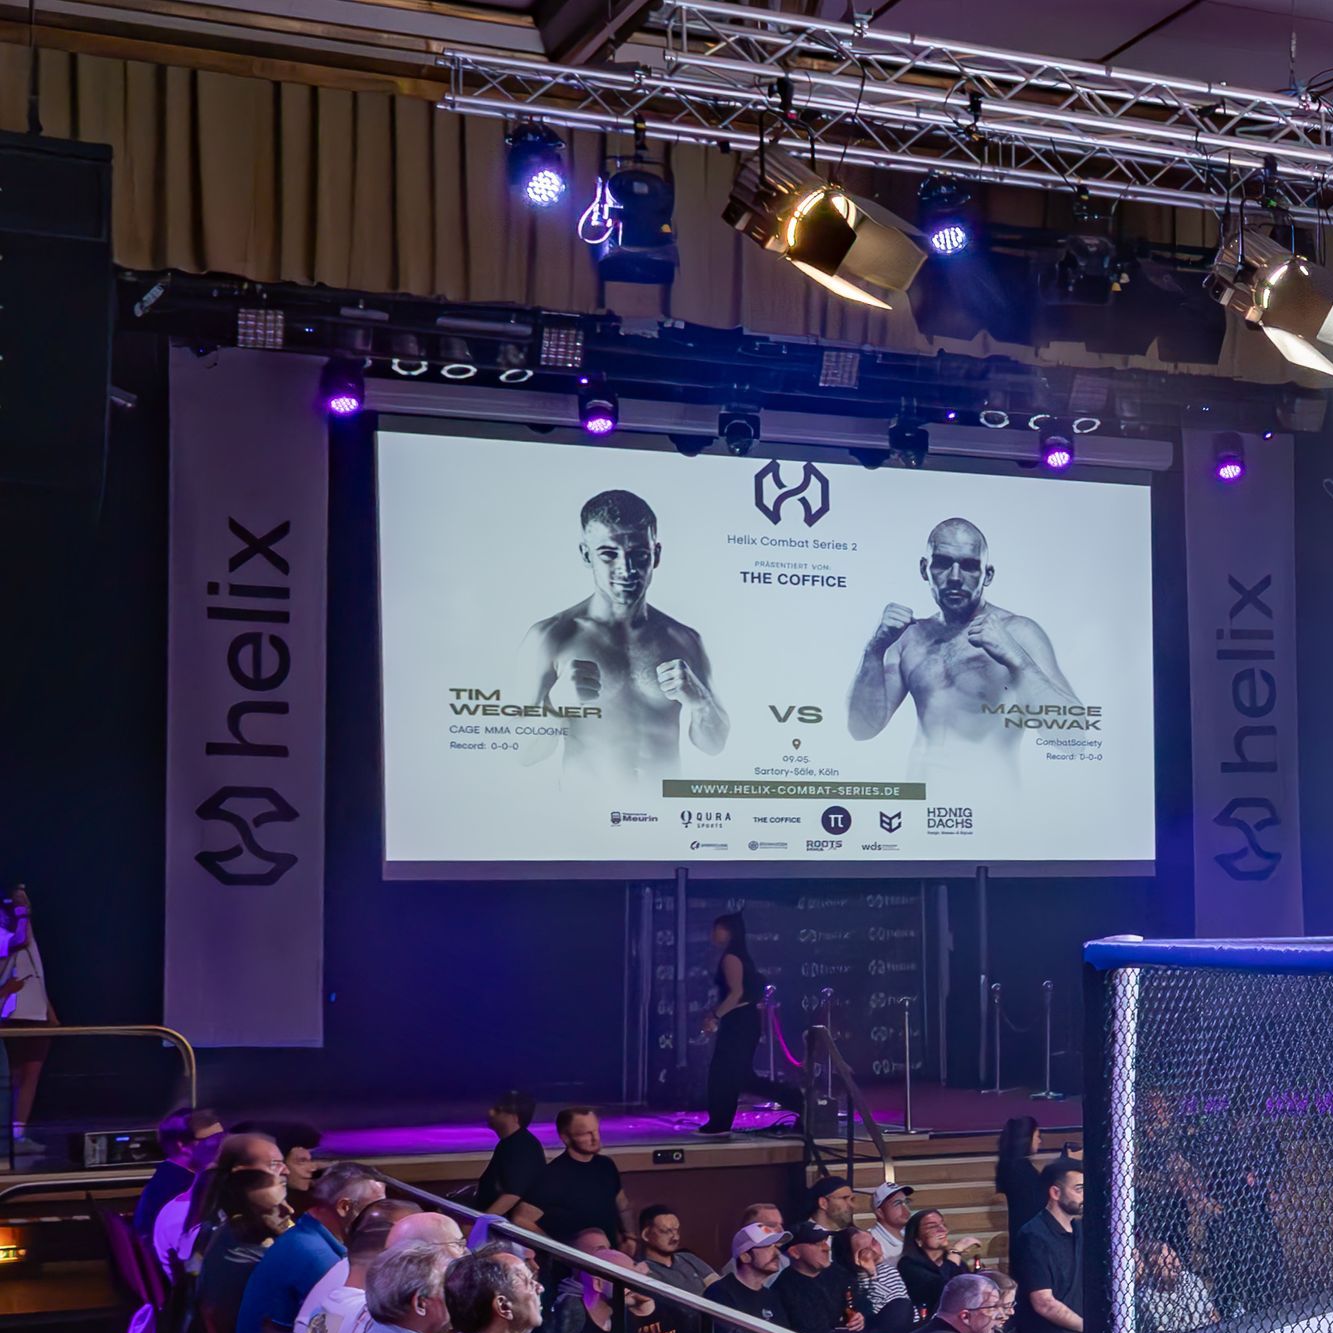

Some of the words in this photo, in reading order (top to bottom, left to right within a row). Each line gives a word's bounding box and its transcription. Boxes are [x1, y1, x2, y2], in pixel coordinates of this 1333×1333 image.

[727, 534, 757, 545] Helix
[760, 536, 809, 549] Combat
[812, 539, 848, 550] Series
[851, 542, 858, 551] 2
[754, 560, 808, 570] PRÄSENTIERT
[740, 571, 772, 584] THE
[777, 573, 847, 588] COFFICE
[205, 516, 292, 758] helix
[1215, 573, 1279, 774] helix
[449, 688, 501, 701] TIM
[449, 703, 602, 719] WEGENER
[768, 705, 823, 724] VS
[980, 703, 1102, 717] MAURICE
[1004, 717, 1102, 731] NOWAK
[449, 725, 480, 734] CAGE
[485, 726, 511, 735] MMA
[515, 726, 569, 736] COLOGNE
[450, 741, 486, 750] Record:
[491, 742, 519, 750] 0-0-0
[1036, 738, 1102, 748] CombatSociety
[1046, 752, 1076, 761] Record:
[818, 767, 840, 776] Köln
[690, 784, 900, 796] WWW.HELIX-COMBAT-SERIES.DE
[696, 812, 731, 821] QURA
[927, 819, 973, 829] DACHS
